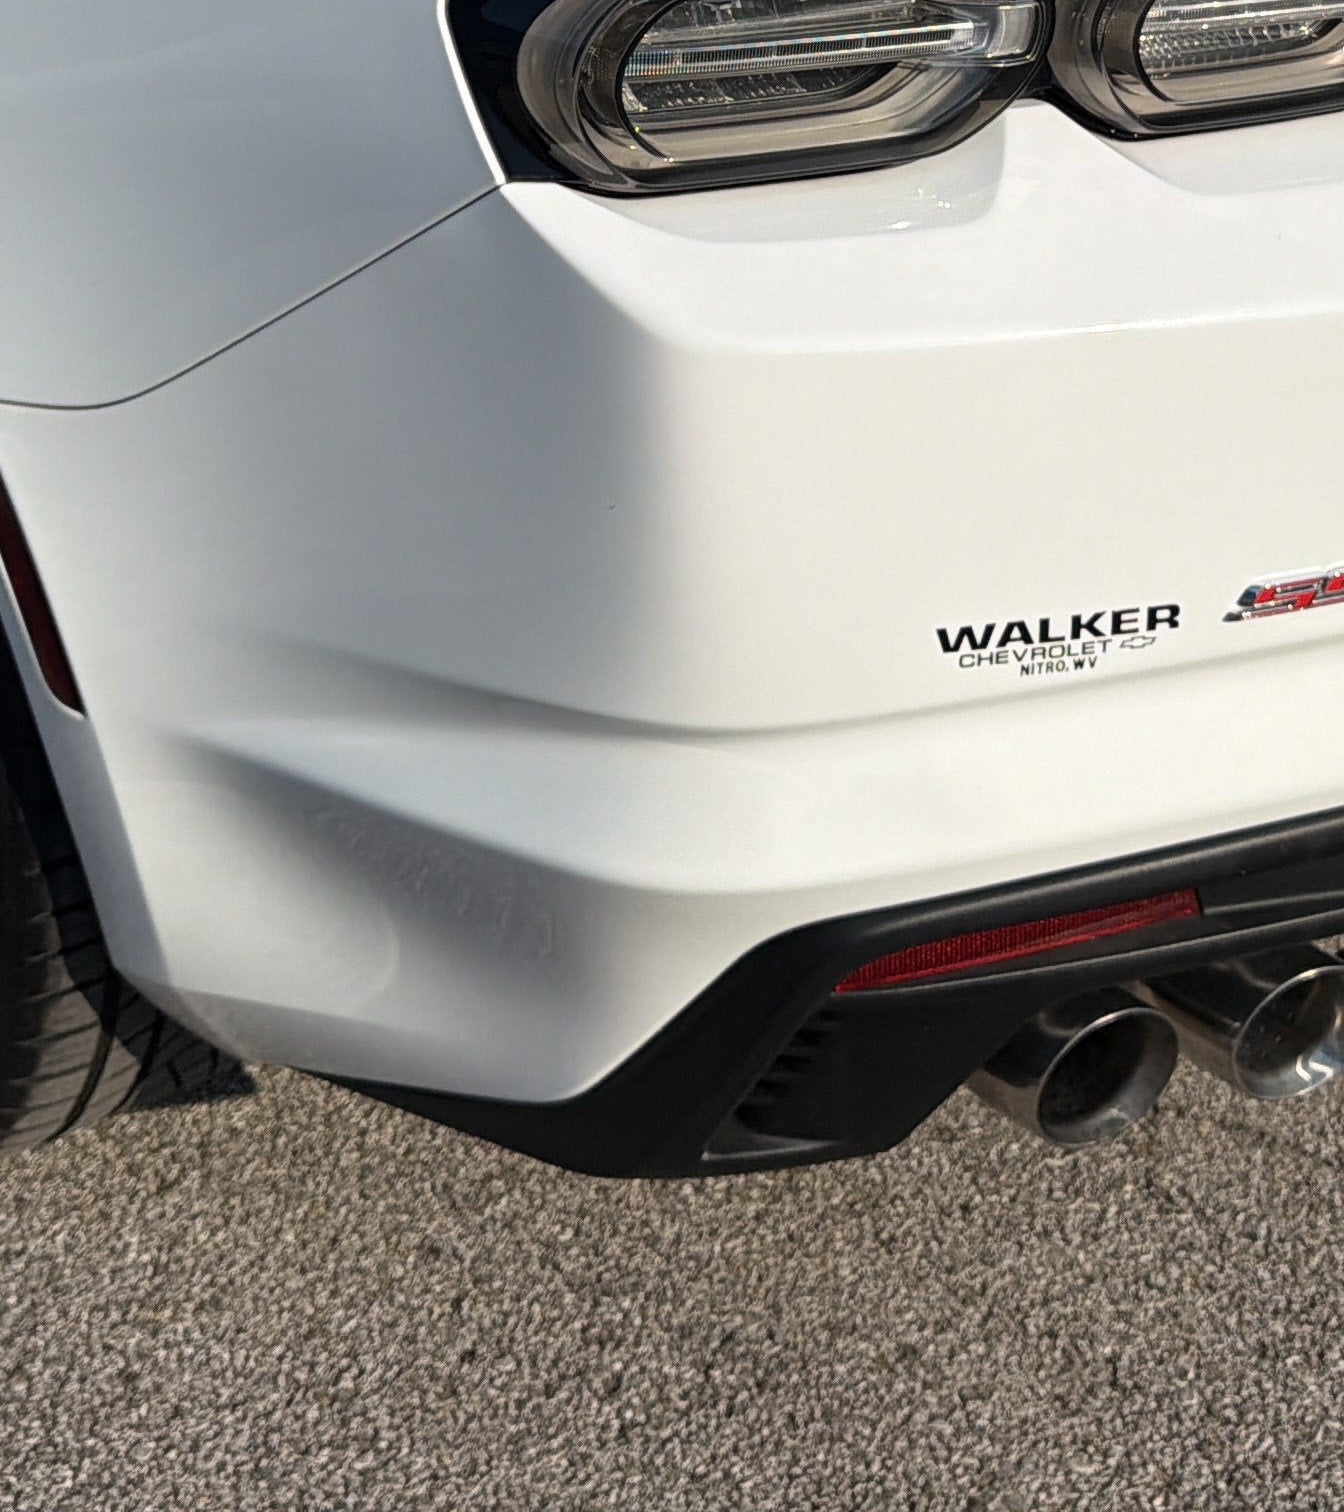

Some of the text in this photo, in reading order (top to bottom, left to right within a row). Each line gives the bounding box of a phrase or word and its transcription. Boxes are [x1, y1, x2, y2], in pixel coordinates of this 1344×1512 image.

[935, 603, 1181, 654] WALKER
[958, 638, 1114, 670] CHEVROLET
[1073, 655, 1098, 671] WV
